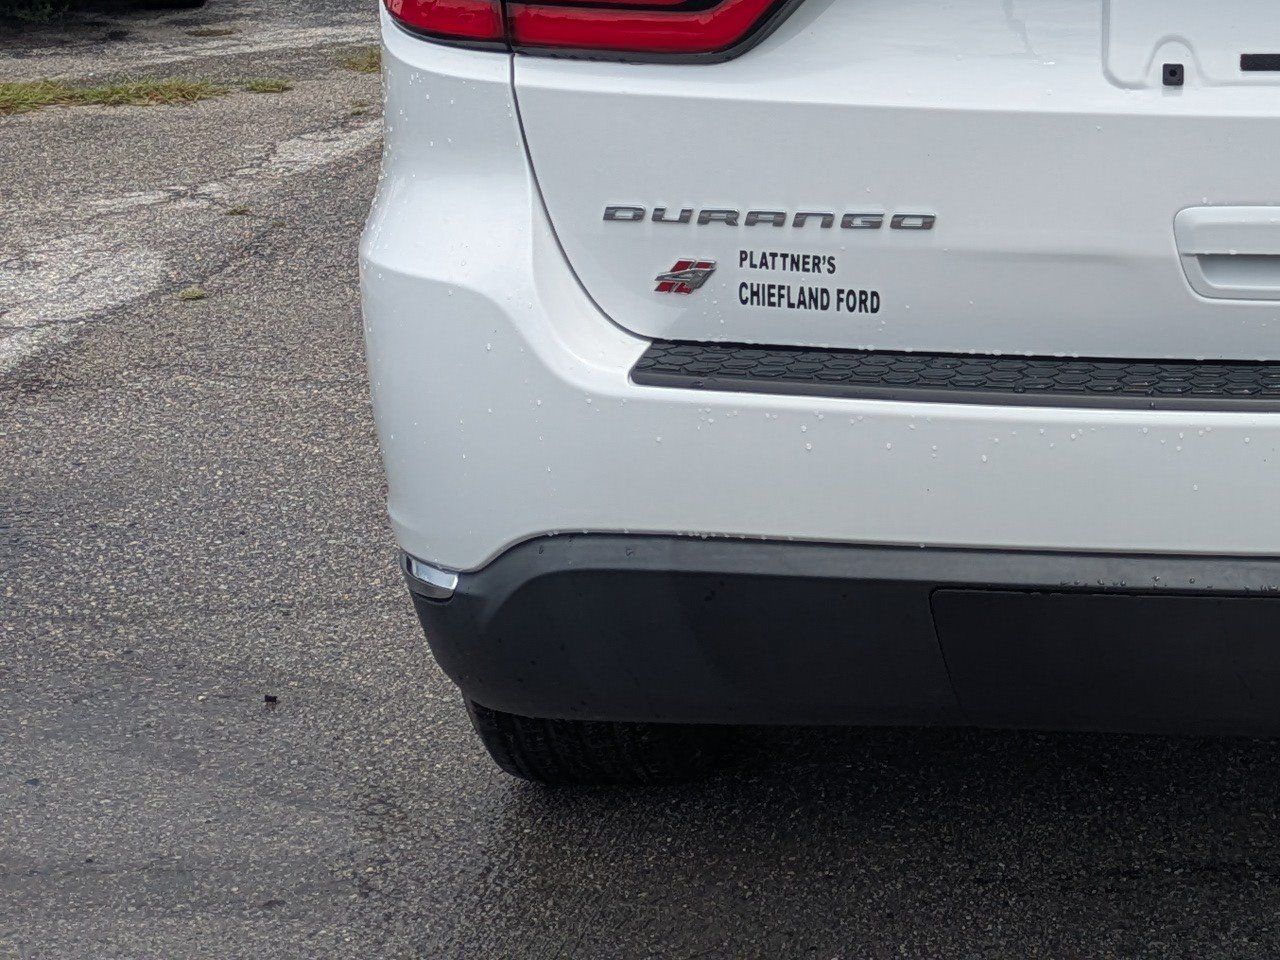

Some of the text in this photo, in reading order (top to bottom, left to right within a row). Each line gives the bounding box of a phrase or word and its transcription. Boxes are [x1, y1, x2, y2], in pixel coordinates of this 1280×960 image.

[603, 206, 936, 230] DURANGO
[739, 250, 836, 274] PLATTNER'S
[739, 282, 881, 314] CHIEFLAND FORD
